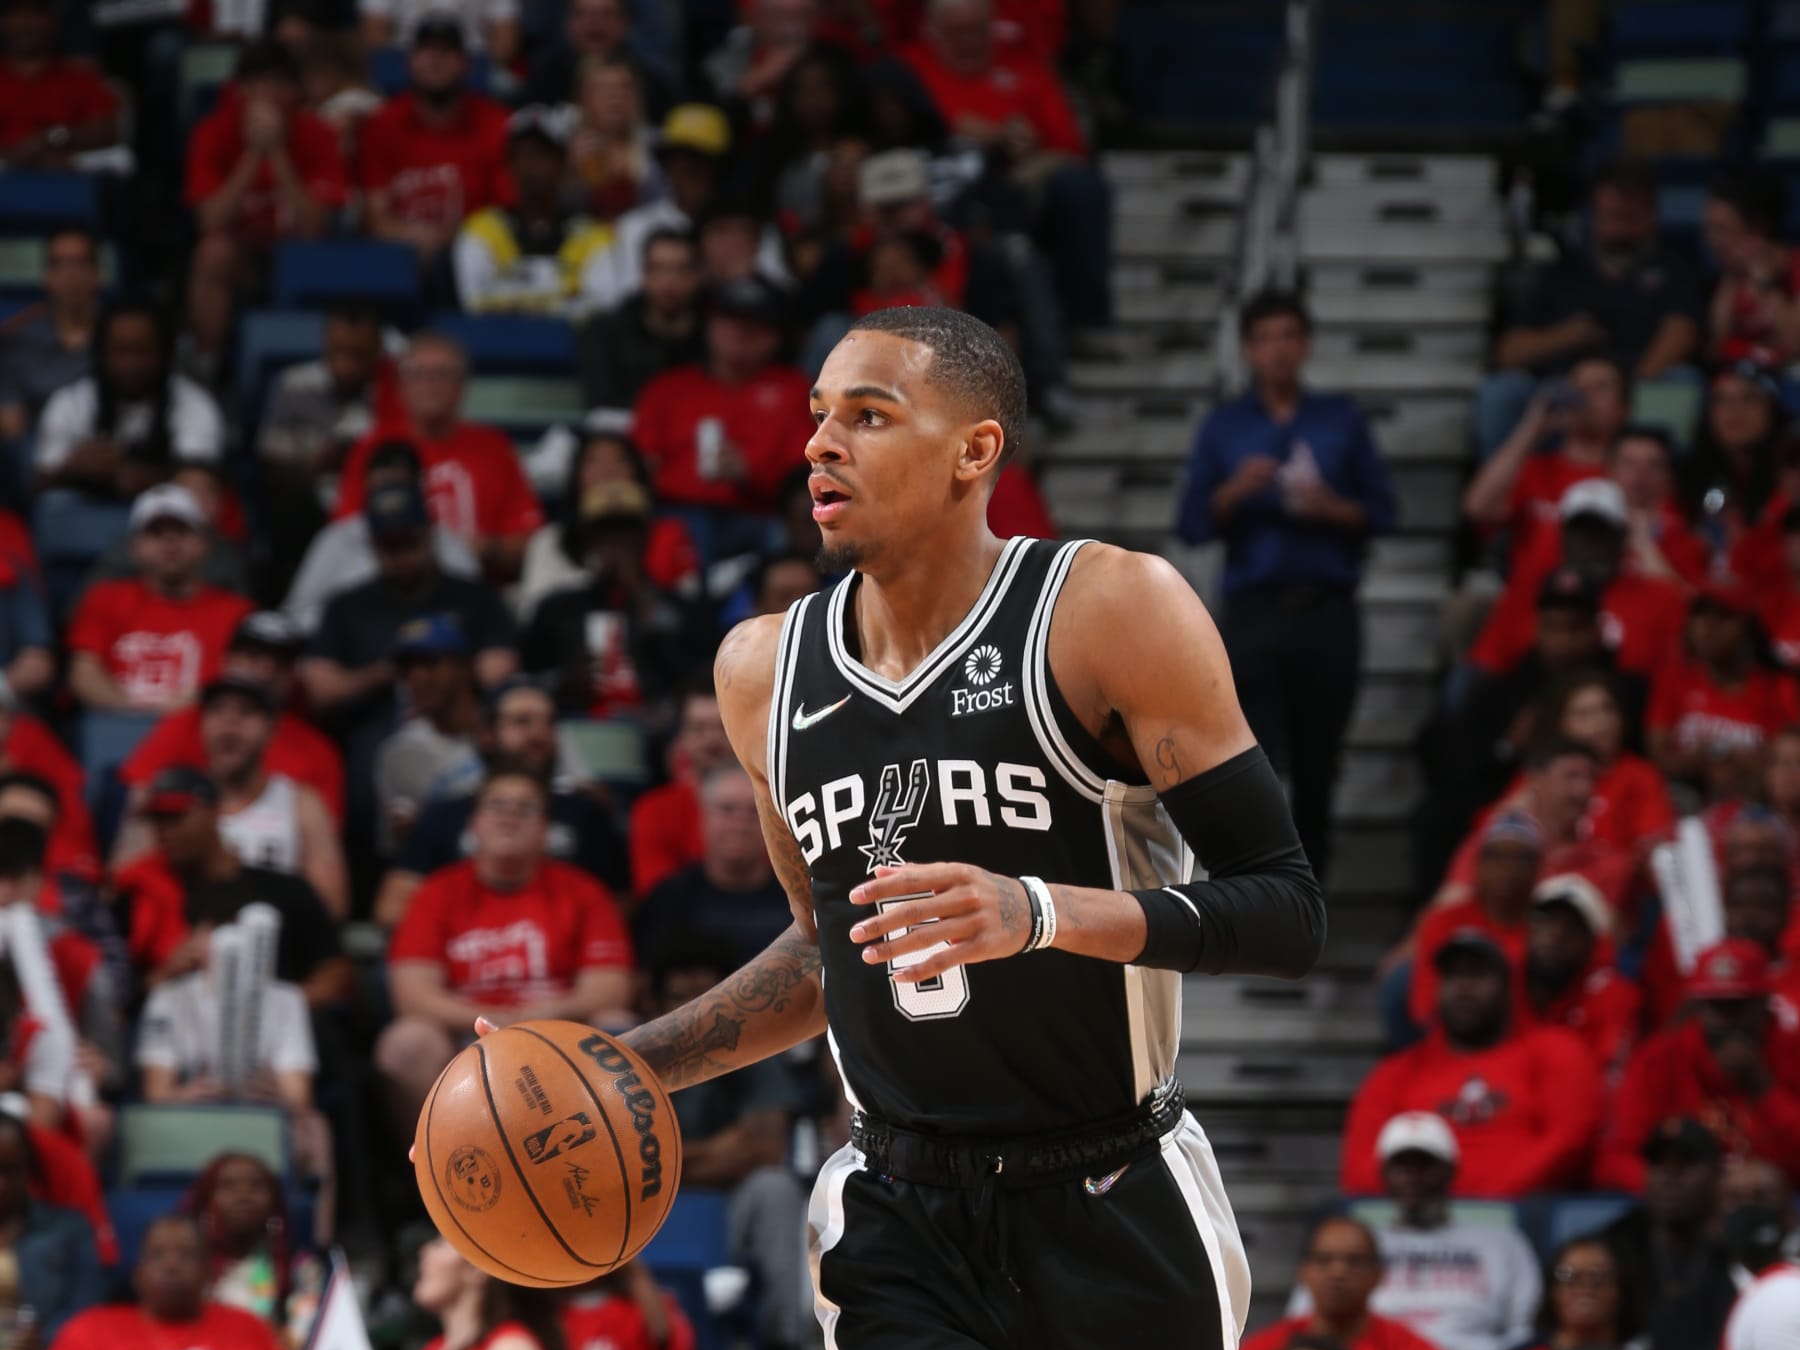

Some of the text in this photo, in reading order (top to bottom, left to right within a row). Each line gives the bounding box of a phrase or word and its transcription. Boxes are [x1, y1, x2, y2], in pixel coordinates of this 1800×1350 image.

[951, 681, 1013, 716] Frost
[787, 758, 1052, 875] SPURS
[579, 1033, 662, 1202] Wilson
